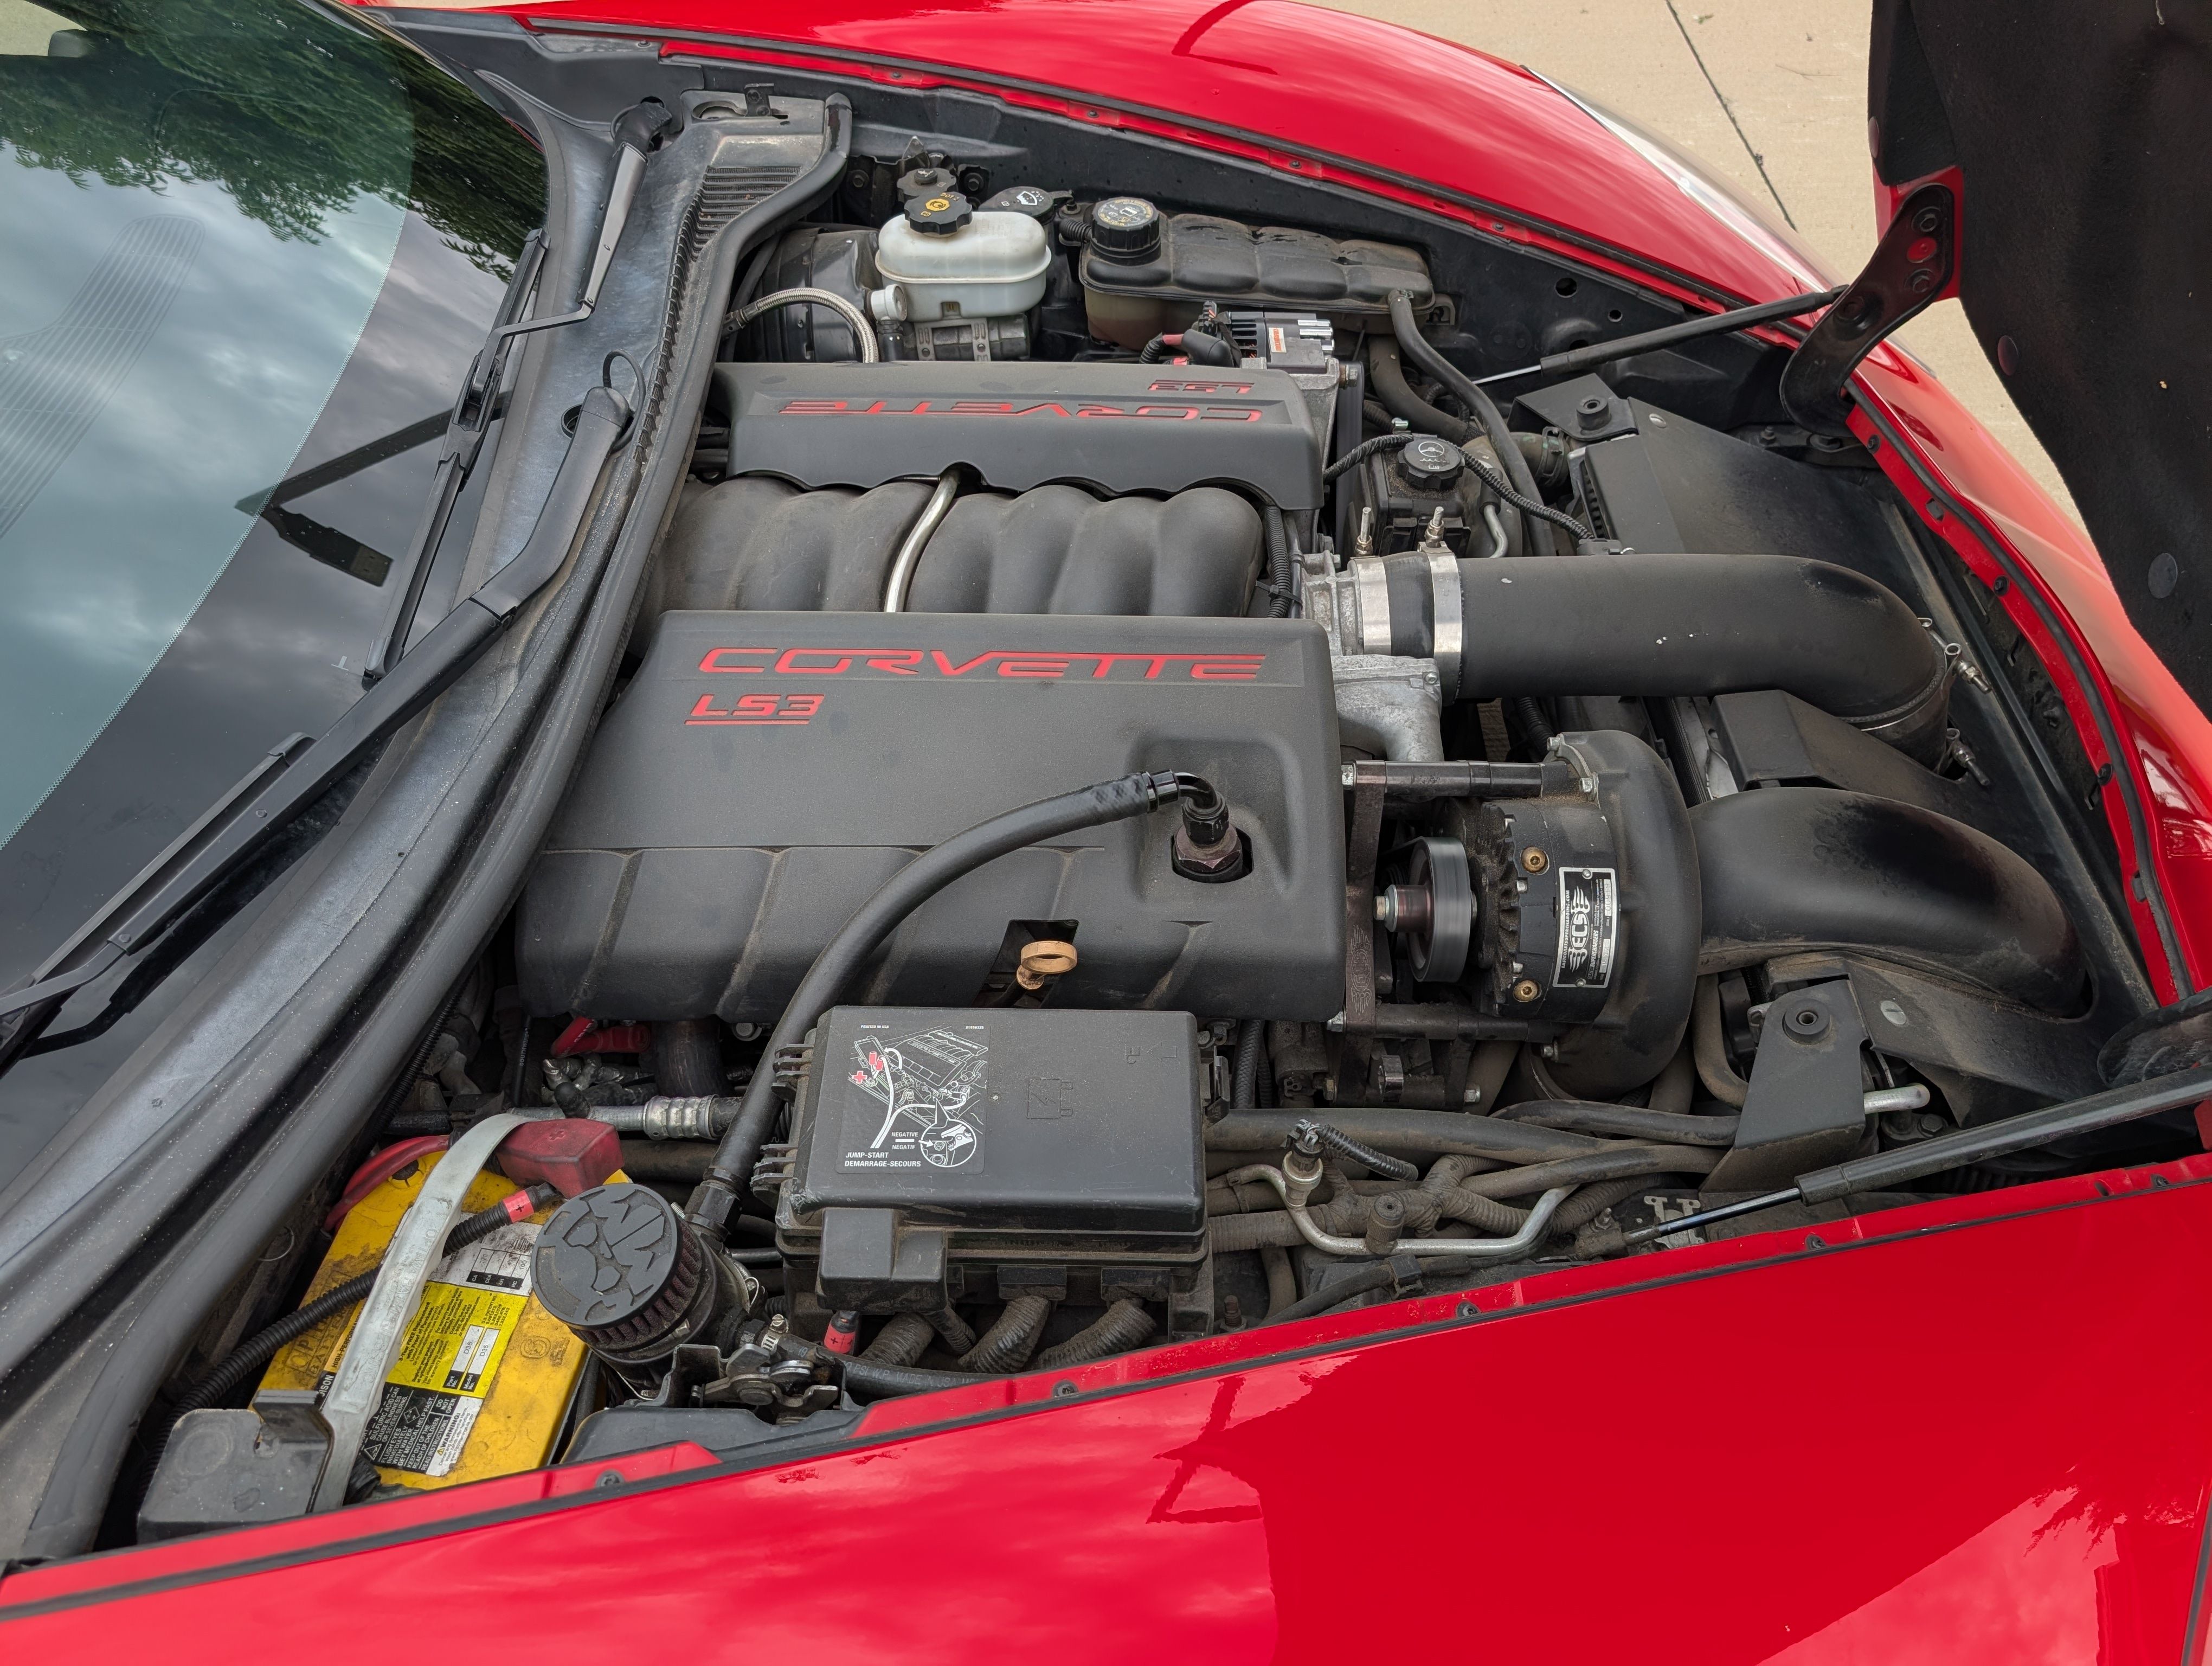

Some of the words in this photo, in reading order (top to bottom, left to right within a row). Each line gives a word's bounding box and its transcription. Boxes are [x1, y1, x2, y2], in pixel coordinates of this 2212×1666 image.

[1148, 380, 1255, 394] LS3
[779, 400, 1263, 422] CORVETTE
[699, 647, 1266, 680] CORVETTE
[689, 694, 825, 717] LS3
[1572, 914, 1589, 948] ECS
[519, 1260, 528, 1270] 100
[406, 1331, 416, 1345] FREE
[413, 1301, 431, 1331] Replacement
[485, 1301, 494, 1316] PATENT
[406, 1348, 414, 1359] with
[411, 1334, 421, 1348] Proof
[463, 1341, 473, 1354] D35
[479, 1344, 489, 1356] D35
[446, 1375, 455, 1386] Part
[462, 1374, 473, 1389] Model
[896, 1371, 922, 1385] MADE
[369, 1412, 388, 1440] SULFURIC
[384, 1397, 395, 1411] ACID
[390, 1387, 400, 1398] CAN
[376, 1424, 388, 1441] CAUSE
[384, 1395, 402, 1424] BLINDNESS
[382, 1434, 390, 1442] OR
[386, 1414, 399, 1434] SEVERE
[395, 1395, 408, 1414] BURNS.
[435, 1399, 443, 1407] DO
[440, 1398, 450, 1410] NOT
[445, 1396, 457, 1413] OPEN.
[381, 1444, 394, 1463] FLUSH
[390, 1427, 402, 1443] EYES
[387, 1425, 409, 1464] IMMEDIATELY
[391, 1449, 403, 1464] WITH
[400, 1426, 414, 1449] WATER.
[397, 1454, 407, 1466] GET
[403, 1427, 420, 1454] MEDICAL
[416, 1412, 427, 1427] HELP
[423, 1396, 435, 1412] FAST.
[407, 1453, 417, 1468] KEEP
[413, 1443, 422, 1453] OUT
[421, 1424, 430, 1435] THE
[412, 1451, 425, 1468] REACH
[424, 1416, 440, 1443] CHILDREN.
[421, 1456, 432, 1470] READ
[427, 1418, 449, 1456] INSTRUCTIONS.
[438, 1451, 448, 1466] Cancer
[448, 1418, 462, 1443] Reproductive
[441, 1412, 461, 1447] WARNING:
